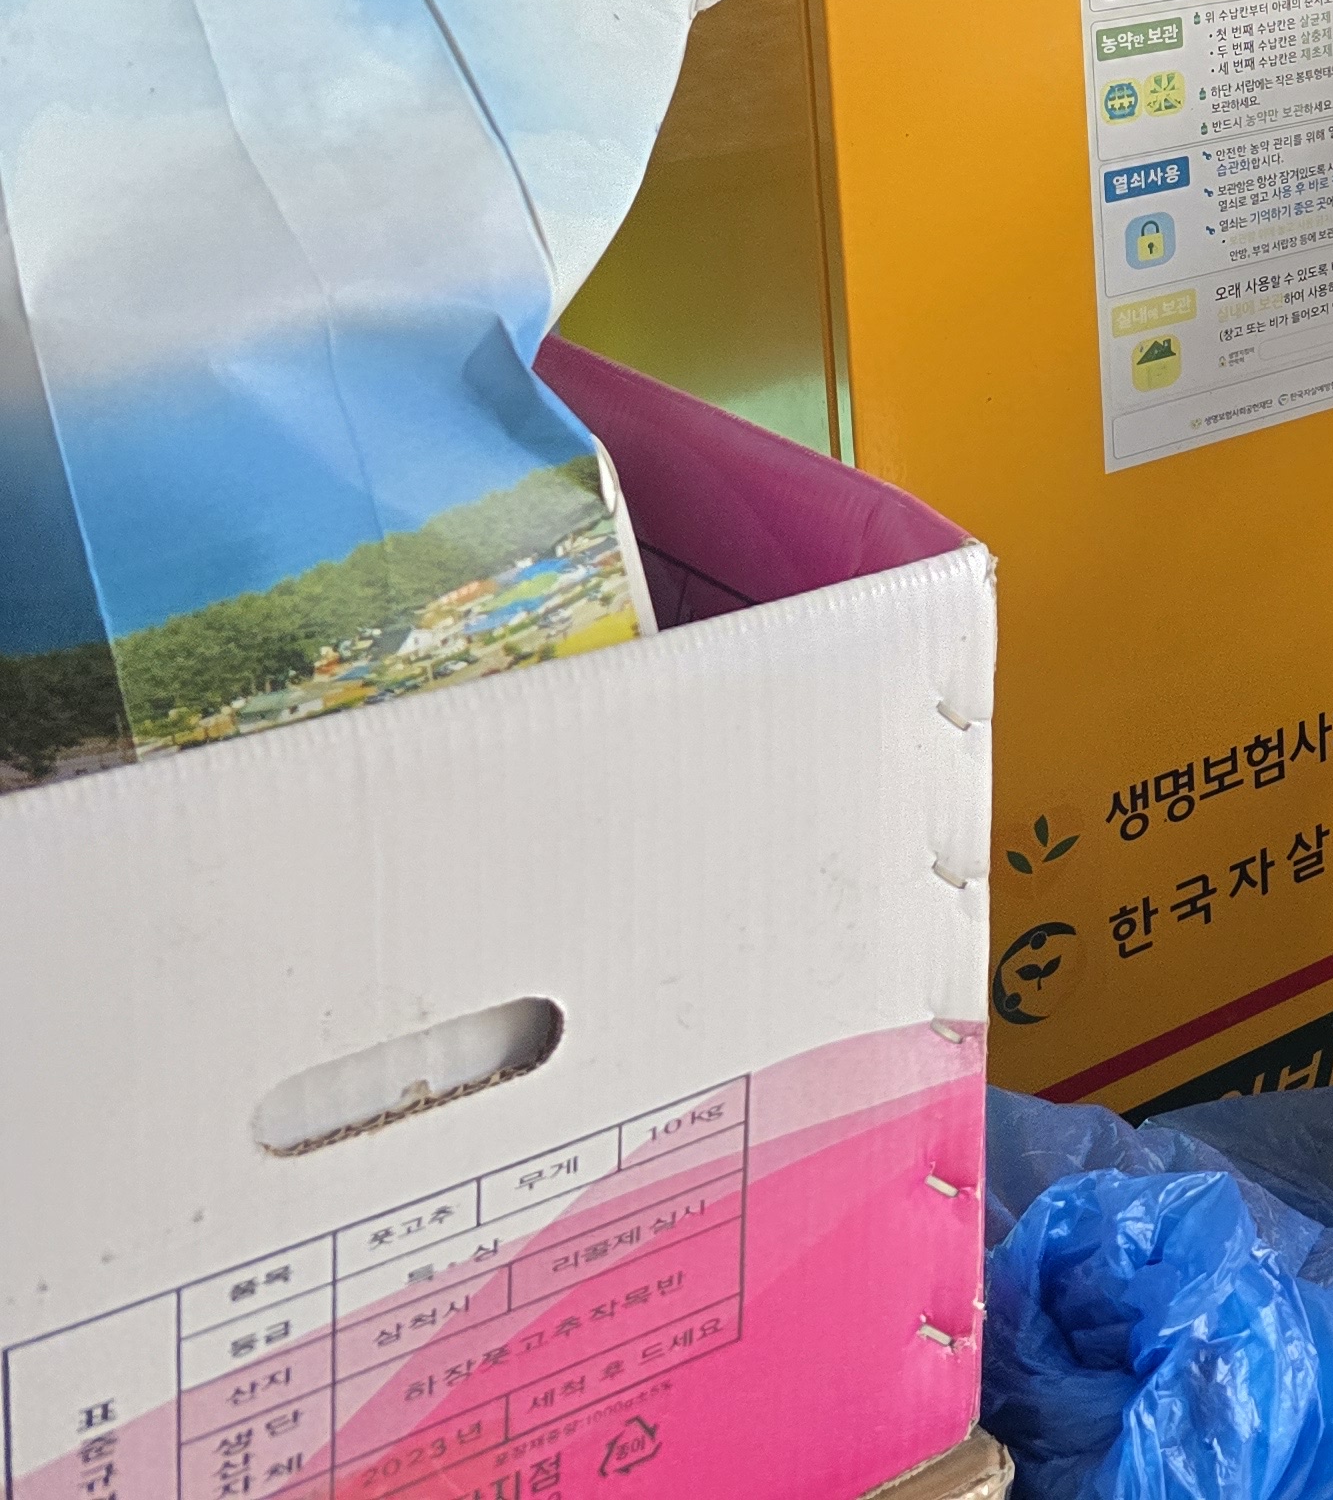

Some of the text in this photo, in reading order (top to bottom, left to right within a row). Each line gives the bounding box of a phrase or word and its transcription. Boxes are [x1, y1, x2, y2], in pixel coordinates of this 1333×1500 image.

[1205, 11, 1215, 23] 위
[1219, 2, 1268, 22] 수납칸부터
[1232, 11, 1332, 38] 번째 수납칸은 살균제
[1147, 23, 1179, 46] 보관
[1218, 27, 1332, 58] 두 번째 수납칸은 살충제
[1218, 44, 1332, 75] 세 번째 수납칸은 제초제
[1211, 84, 1232, 98] 하단
[1212, 108, 1278, 132] 반드시 농약만
[1216, 145, 1247, 162] 안전한
[1250, 140, 1269, 155] 농약
[1273, 135, 1302, 150] 관리를
[1306, 129, 1325, 142] 위해
[1112, 165, 1181, 194] 열쇠사용
[1218, 174, 1278, 196] 보관함은 항상
[1272, 178, 1329, 201] 사용 후 바로
[1219, 217, 1248, 233] 열쇠는
[1250, 205, 1291, 224] 기억하기
[1294, 200, 1314, 215] 좋은
[1215, 282, 1241, 301] 오래
[1245, 274, 1281, 294] 사용할
[1284, 272, 1294, 285] 수
[1297, 264, 1328, 281] 있도록
[1219, 326, 1243, 343] (창고
[1246, 321, 1266, 335] 또는
[1270, 316, 1288, 328] 비가
[1291, 304, 1329, 323] 들어오지
[516, 1155, 579, 1190] 무게
[649, 1200, 706, 1235] 실시
[373, 1296, 470, 1348] 삼척시
[230, 1321, 291, 1358] 등급
[527, 1375, 586, 1413] 세척
[640, 1318, 723, 1363] 드세요
[226, 1368, 291, 1405] 산지
[77, 1398, 116, 1500] 표준규
